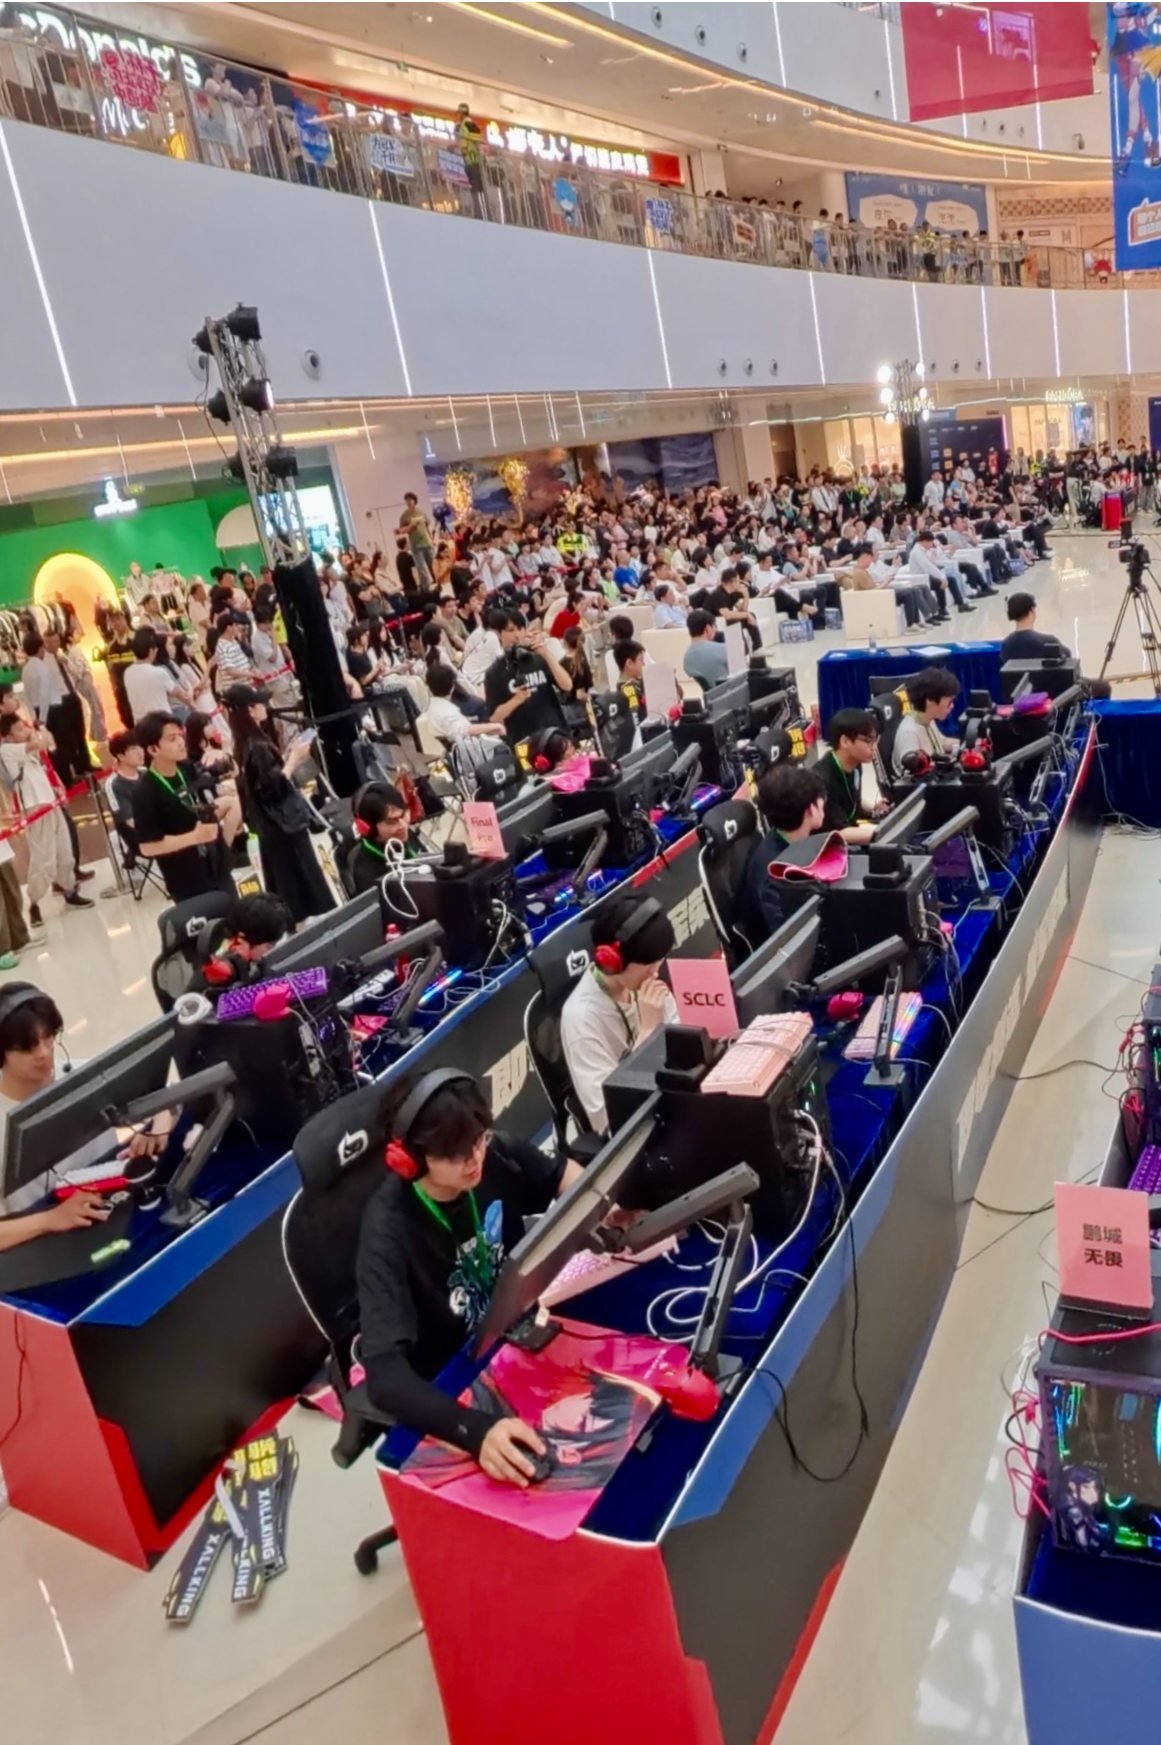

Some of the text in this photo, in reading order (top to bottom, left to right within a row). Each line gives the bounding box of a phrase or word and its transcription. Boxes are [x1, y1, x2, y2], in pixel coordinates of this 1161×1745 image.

[508, 669, 548, 694] CINA
[682, 990, 727, 1008] SCLC
[1083, 1247, 1124, 1269] 无畏
[257, 1487, 275, 1561] XALLKING
[175, 1533, 221, 1618] XALLKING
